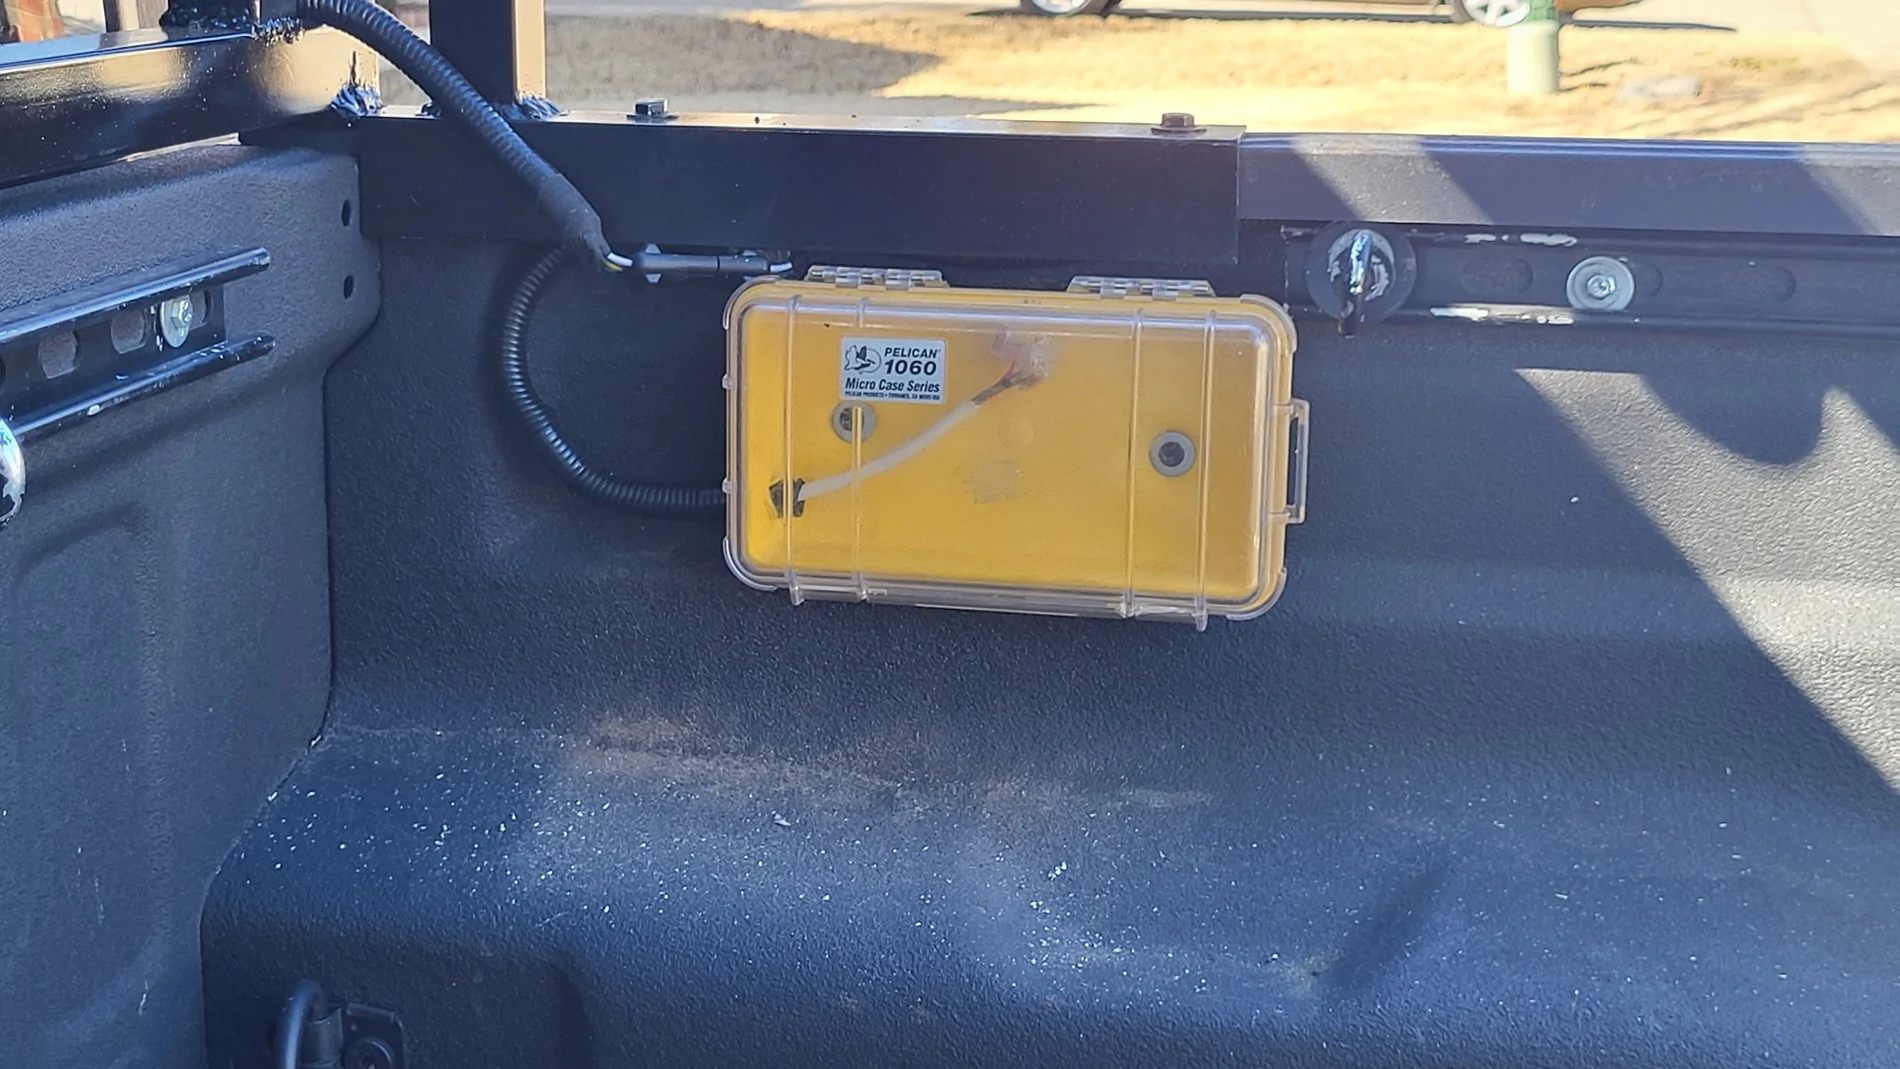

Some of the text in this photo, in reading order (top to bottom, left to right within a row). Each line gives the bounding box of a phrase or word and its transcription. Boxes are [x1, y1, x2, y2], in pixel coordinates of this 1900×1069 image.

[884, 347, 937, 359] PELICAN
[884, 359, 937, 375] 1060
[845, 377, 940, 392] Micro Case Series
